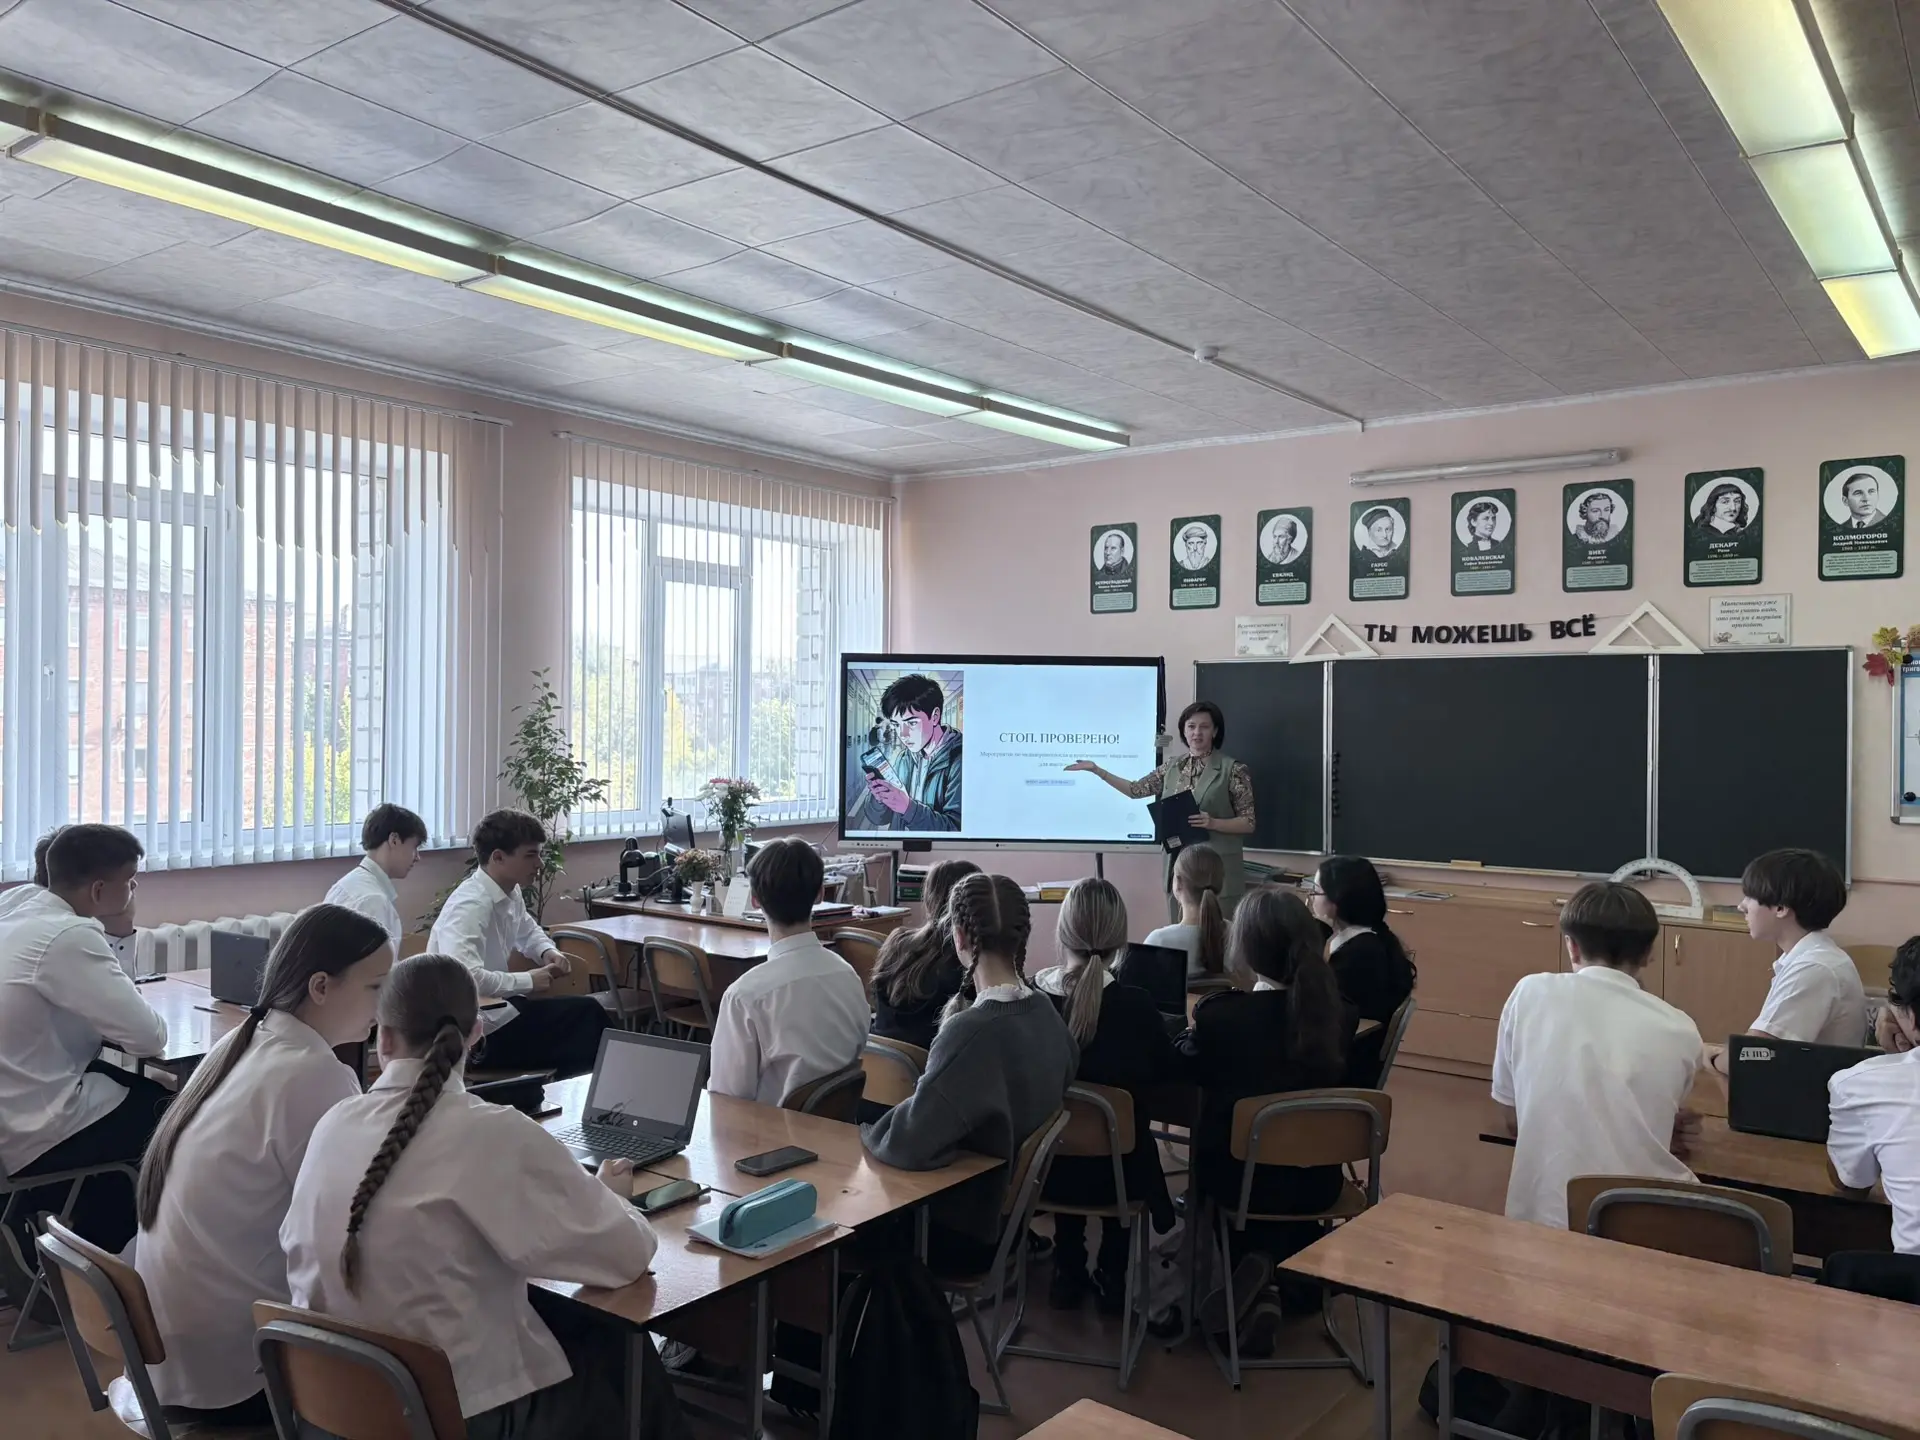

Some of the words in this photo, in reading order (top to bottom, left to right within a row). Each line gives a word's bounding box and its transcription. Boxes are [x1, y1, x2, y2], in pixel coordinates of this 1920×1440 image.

[1832, 532, 1888, 541] КОЛМОГОРОВ
[1364, 624, 1398, 642] ТЫ
[1411, 622, 1532, 644] МОЖЕШЬ
[1550, 614, 1597, 640] ВСЁ
[1000, 732, 1037, 743] СТОП.
[1040, 733, 1120, 744] ПРОВЕРЕНО!
